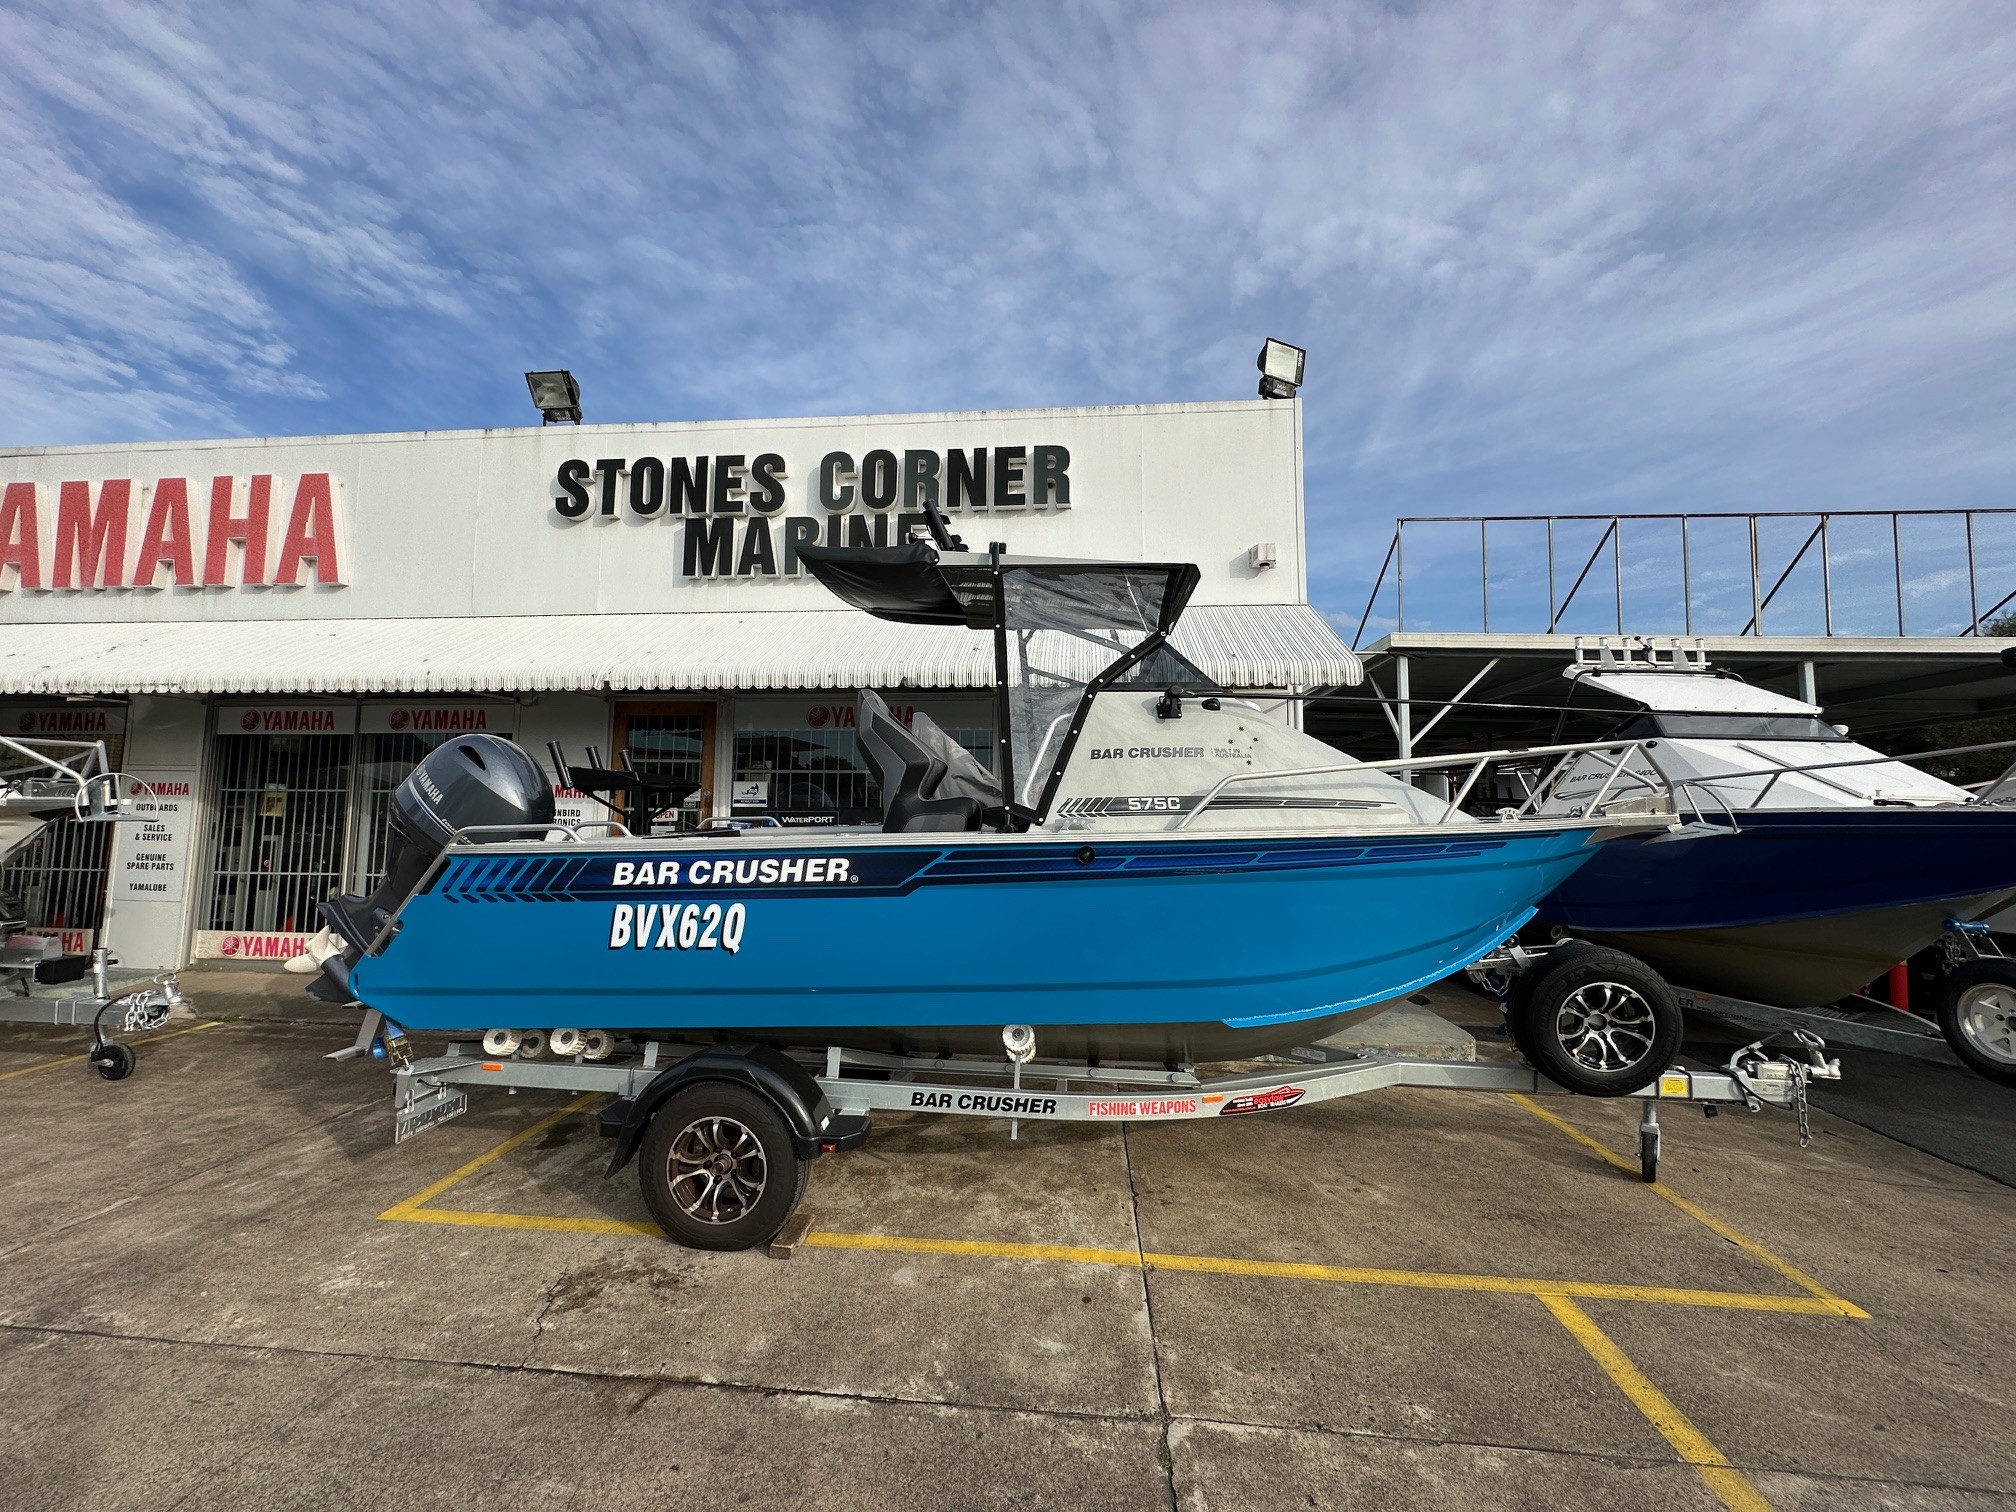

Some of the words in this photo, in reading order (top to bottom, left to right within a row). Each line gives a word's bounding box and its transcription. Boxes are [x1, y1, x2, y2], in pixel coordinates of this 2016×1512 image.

[555, 453, 787, 518] STONES
[820, 444, 1072, 511] CORNER
[0, 472, 342, 589] AMAHA
[39, 712, 107, 732] YAMAHA
[263, 711, 335, 731] YAMAHA
[412, 709, 487, 730] YAMAHA
[831, 706, 914, 728] YAHA
[1090, 748, 1124, 760] BAR
[1128, 747, 1205, 758] CRUSHER
[1569, 775, 1588, 783] BAR
[1587, 771, 1630, 781] CRUSE
[144, 782, 190, 796] YAMAHA
[418, 770, 444, 805] YAMAHA
[136, 803, 178, 812] OUTBARDS
[1128, 797, 1181, 811] 575C
[554, 809, 581, 817] NBIRD
[143, 824, 166, 833] SALES
[135, 833, 140, 841] &
[142, 833, 173, 842] SERVICE
[136, 853, 167, 862] GENUINE
[126, 862, 149, 871] SPARE
[151, 863, 174, 871] PARTS
[612, 861, 680, 886] BAR
[129, 883, 167, 892] YAMALUBE
[609, 902, 746, 955] BVX62Q
[243, 937, 308, 958] YAMAH
[910, 1091, 953, 1109] BAR
[957, 1094, 1057, 1114] CRUSHER
[1088, 1100, 1137, 1116] FISHING
[1139, 1099, 1197, 1115] WEAPONS
